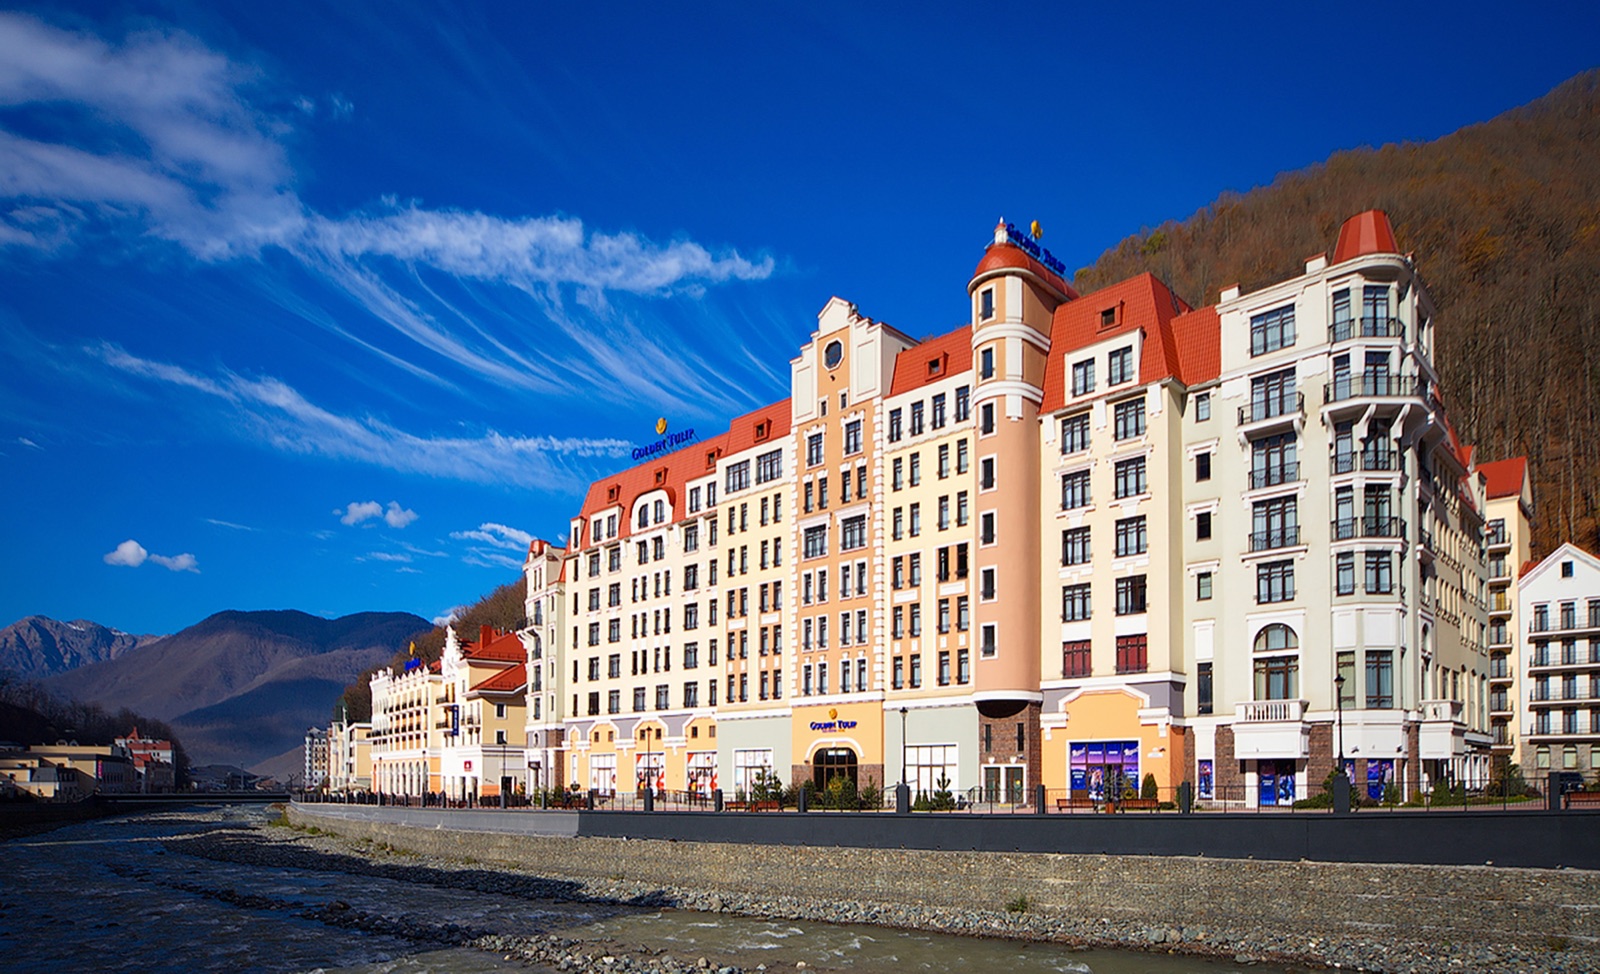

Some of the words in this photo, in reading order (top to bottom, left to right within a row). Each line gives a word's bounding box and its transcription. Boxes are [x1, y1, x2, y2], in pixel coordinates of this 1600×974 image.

[632, 438, 667, 461] GOLDEN
[667, 428, 694, 447] TULIP
[810, 721, 836, 731] GOLDEN
[837, 720, 858, 729] TULIP
